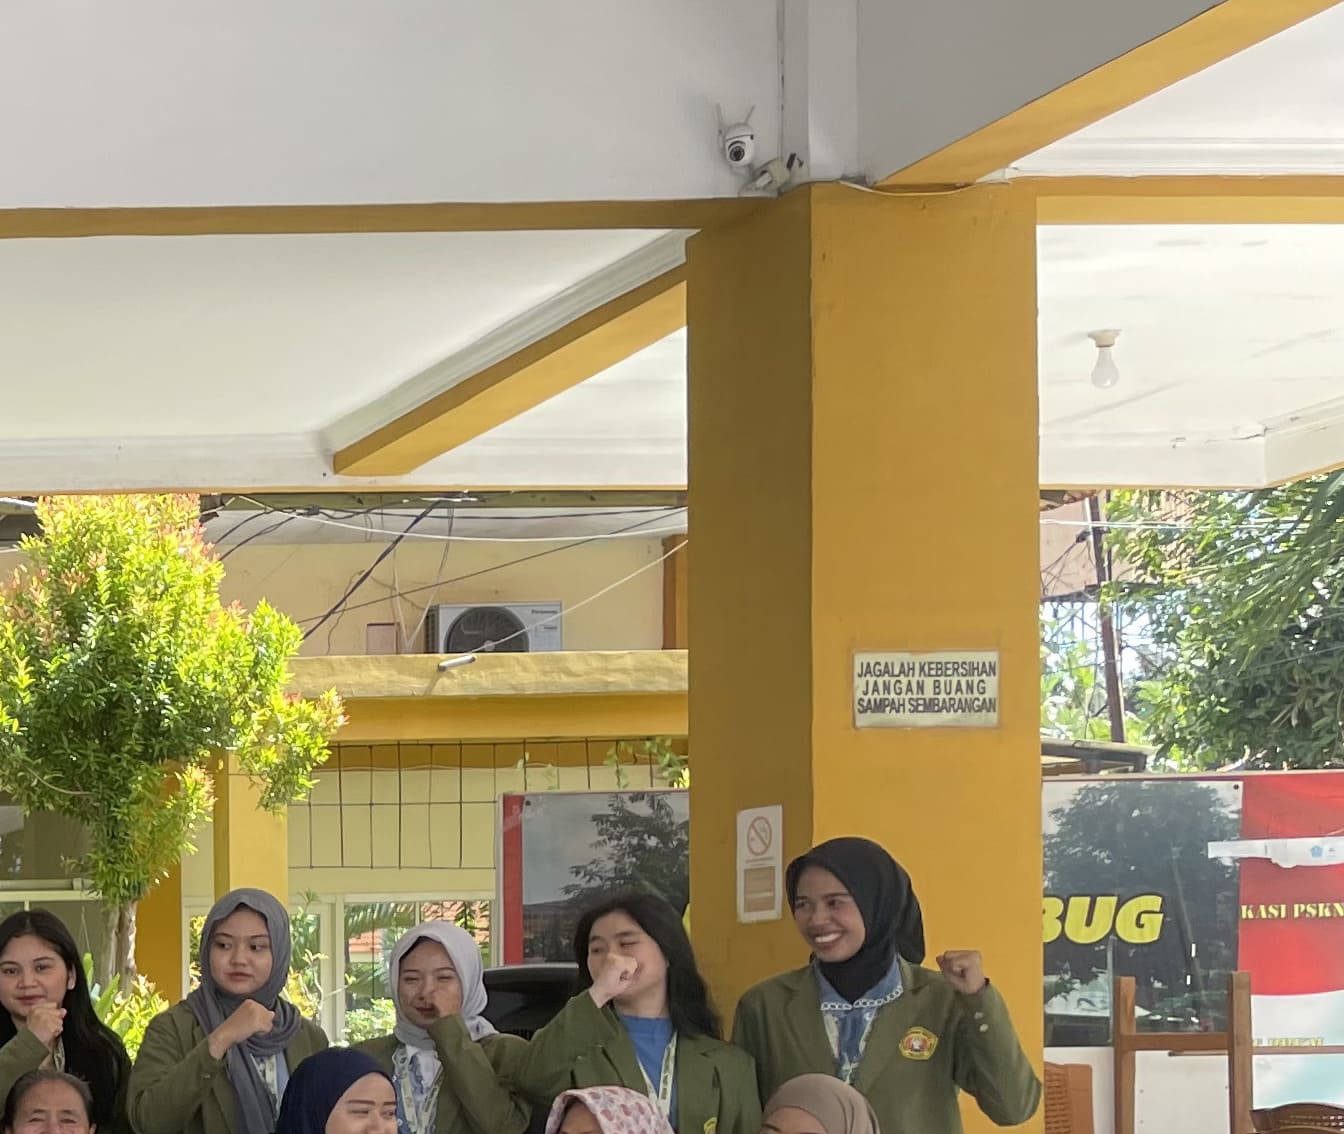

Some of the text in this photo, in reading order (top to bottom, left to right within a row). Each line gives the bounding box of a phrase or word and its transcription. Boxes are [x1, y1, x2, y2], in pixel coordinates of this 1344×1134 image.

[857, 661, 997, 678] JAGALAH KEBERSIHAN
[862, 679, 987, 696] JANGAN BUANG
[857, 697, 997, 715] SAMPAH SEMBARANGAN
